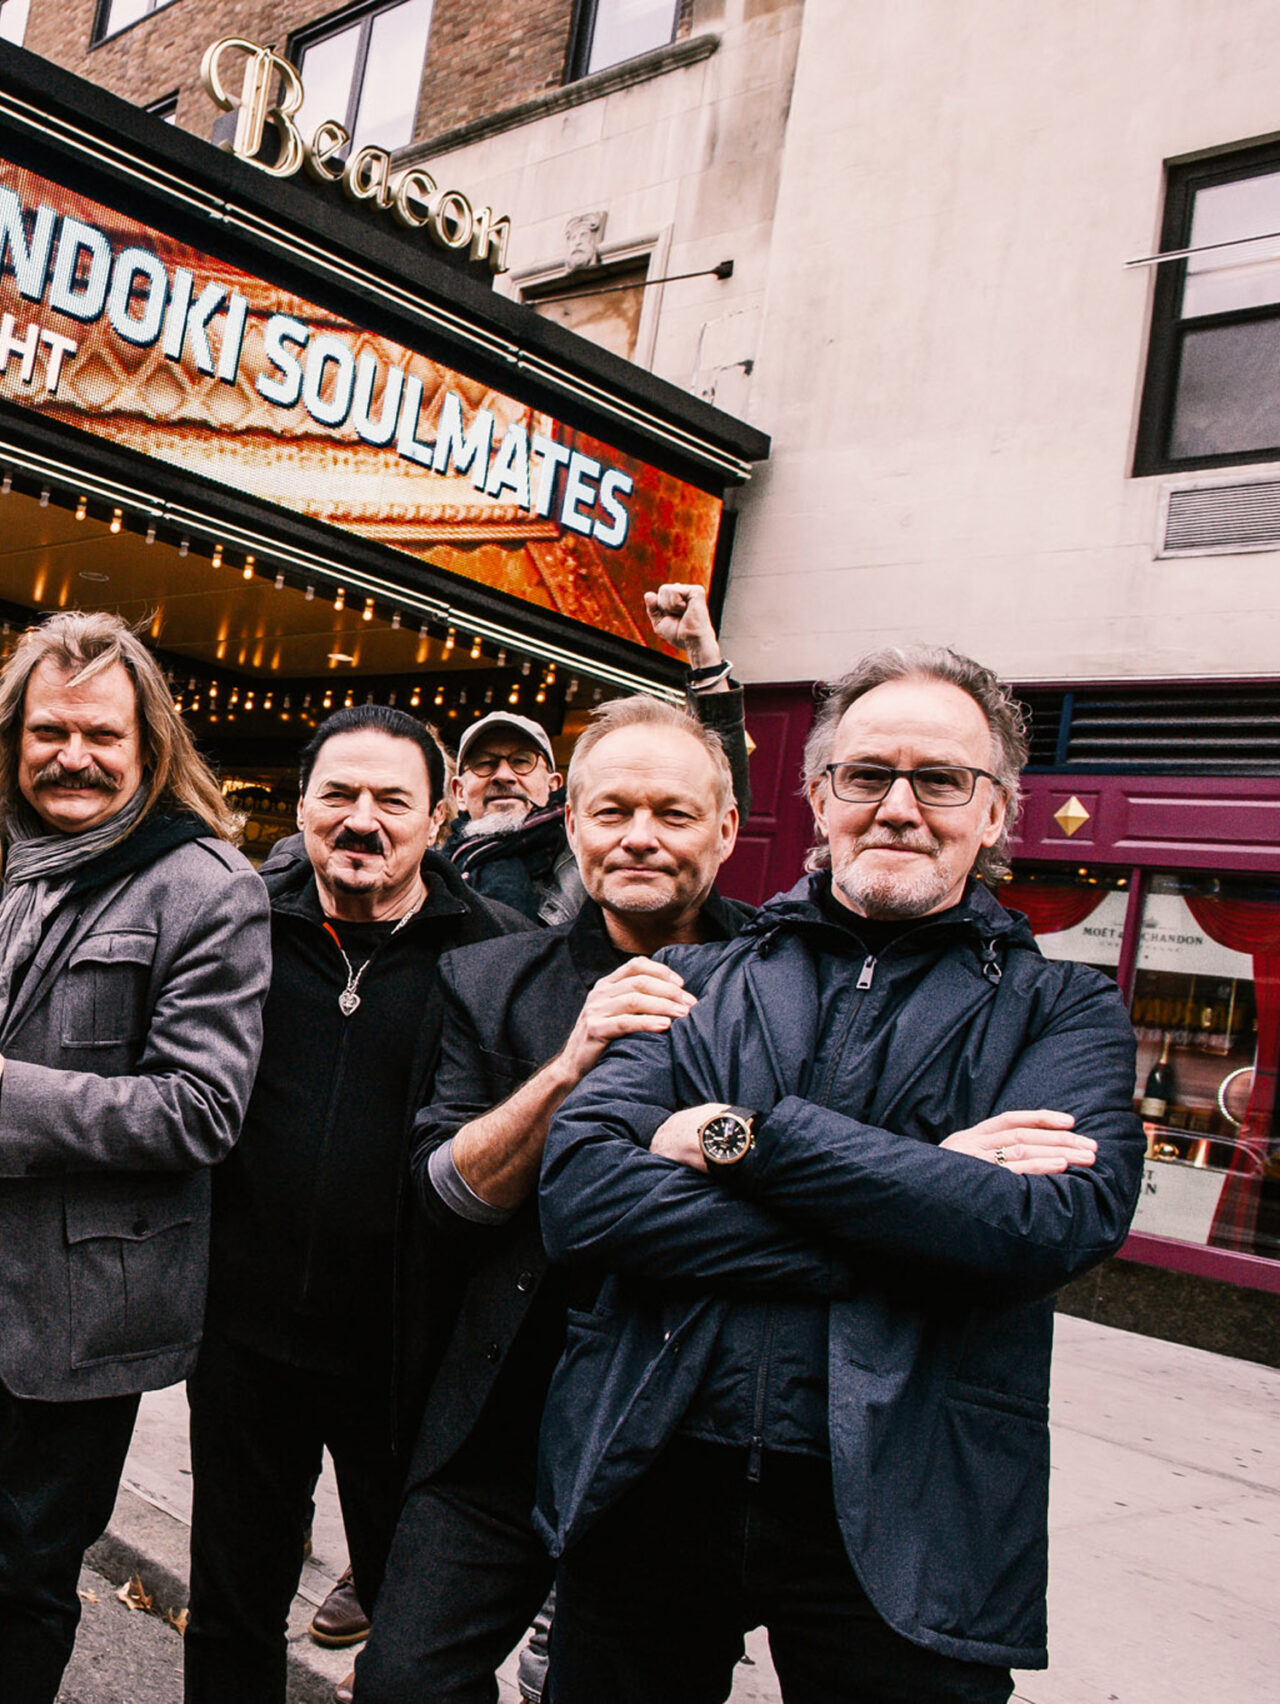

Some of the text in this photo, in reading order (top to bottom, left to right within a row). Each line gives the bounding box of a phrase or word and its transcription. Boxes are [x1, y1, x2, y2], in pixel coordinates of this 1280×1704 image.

[200, 36, 512, 275] Beacon
[255, 313, 634, 548] SOULMATES
[1140, 932, 1204, 945] CHANDON
